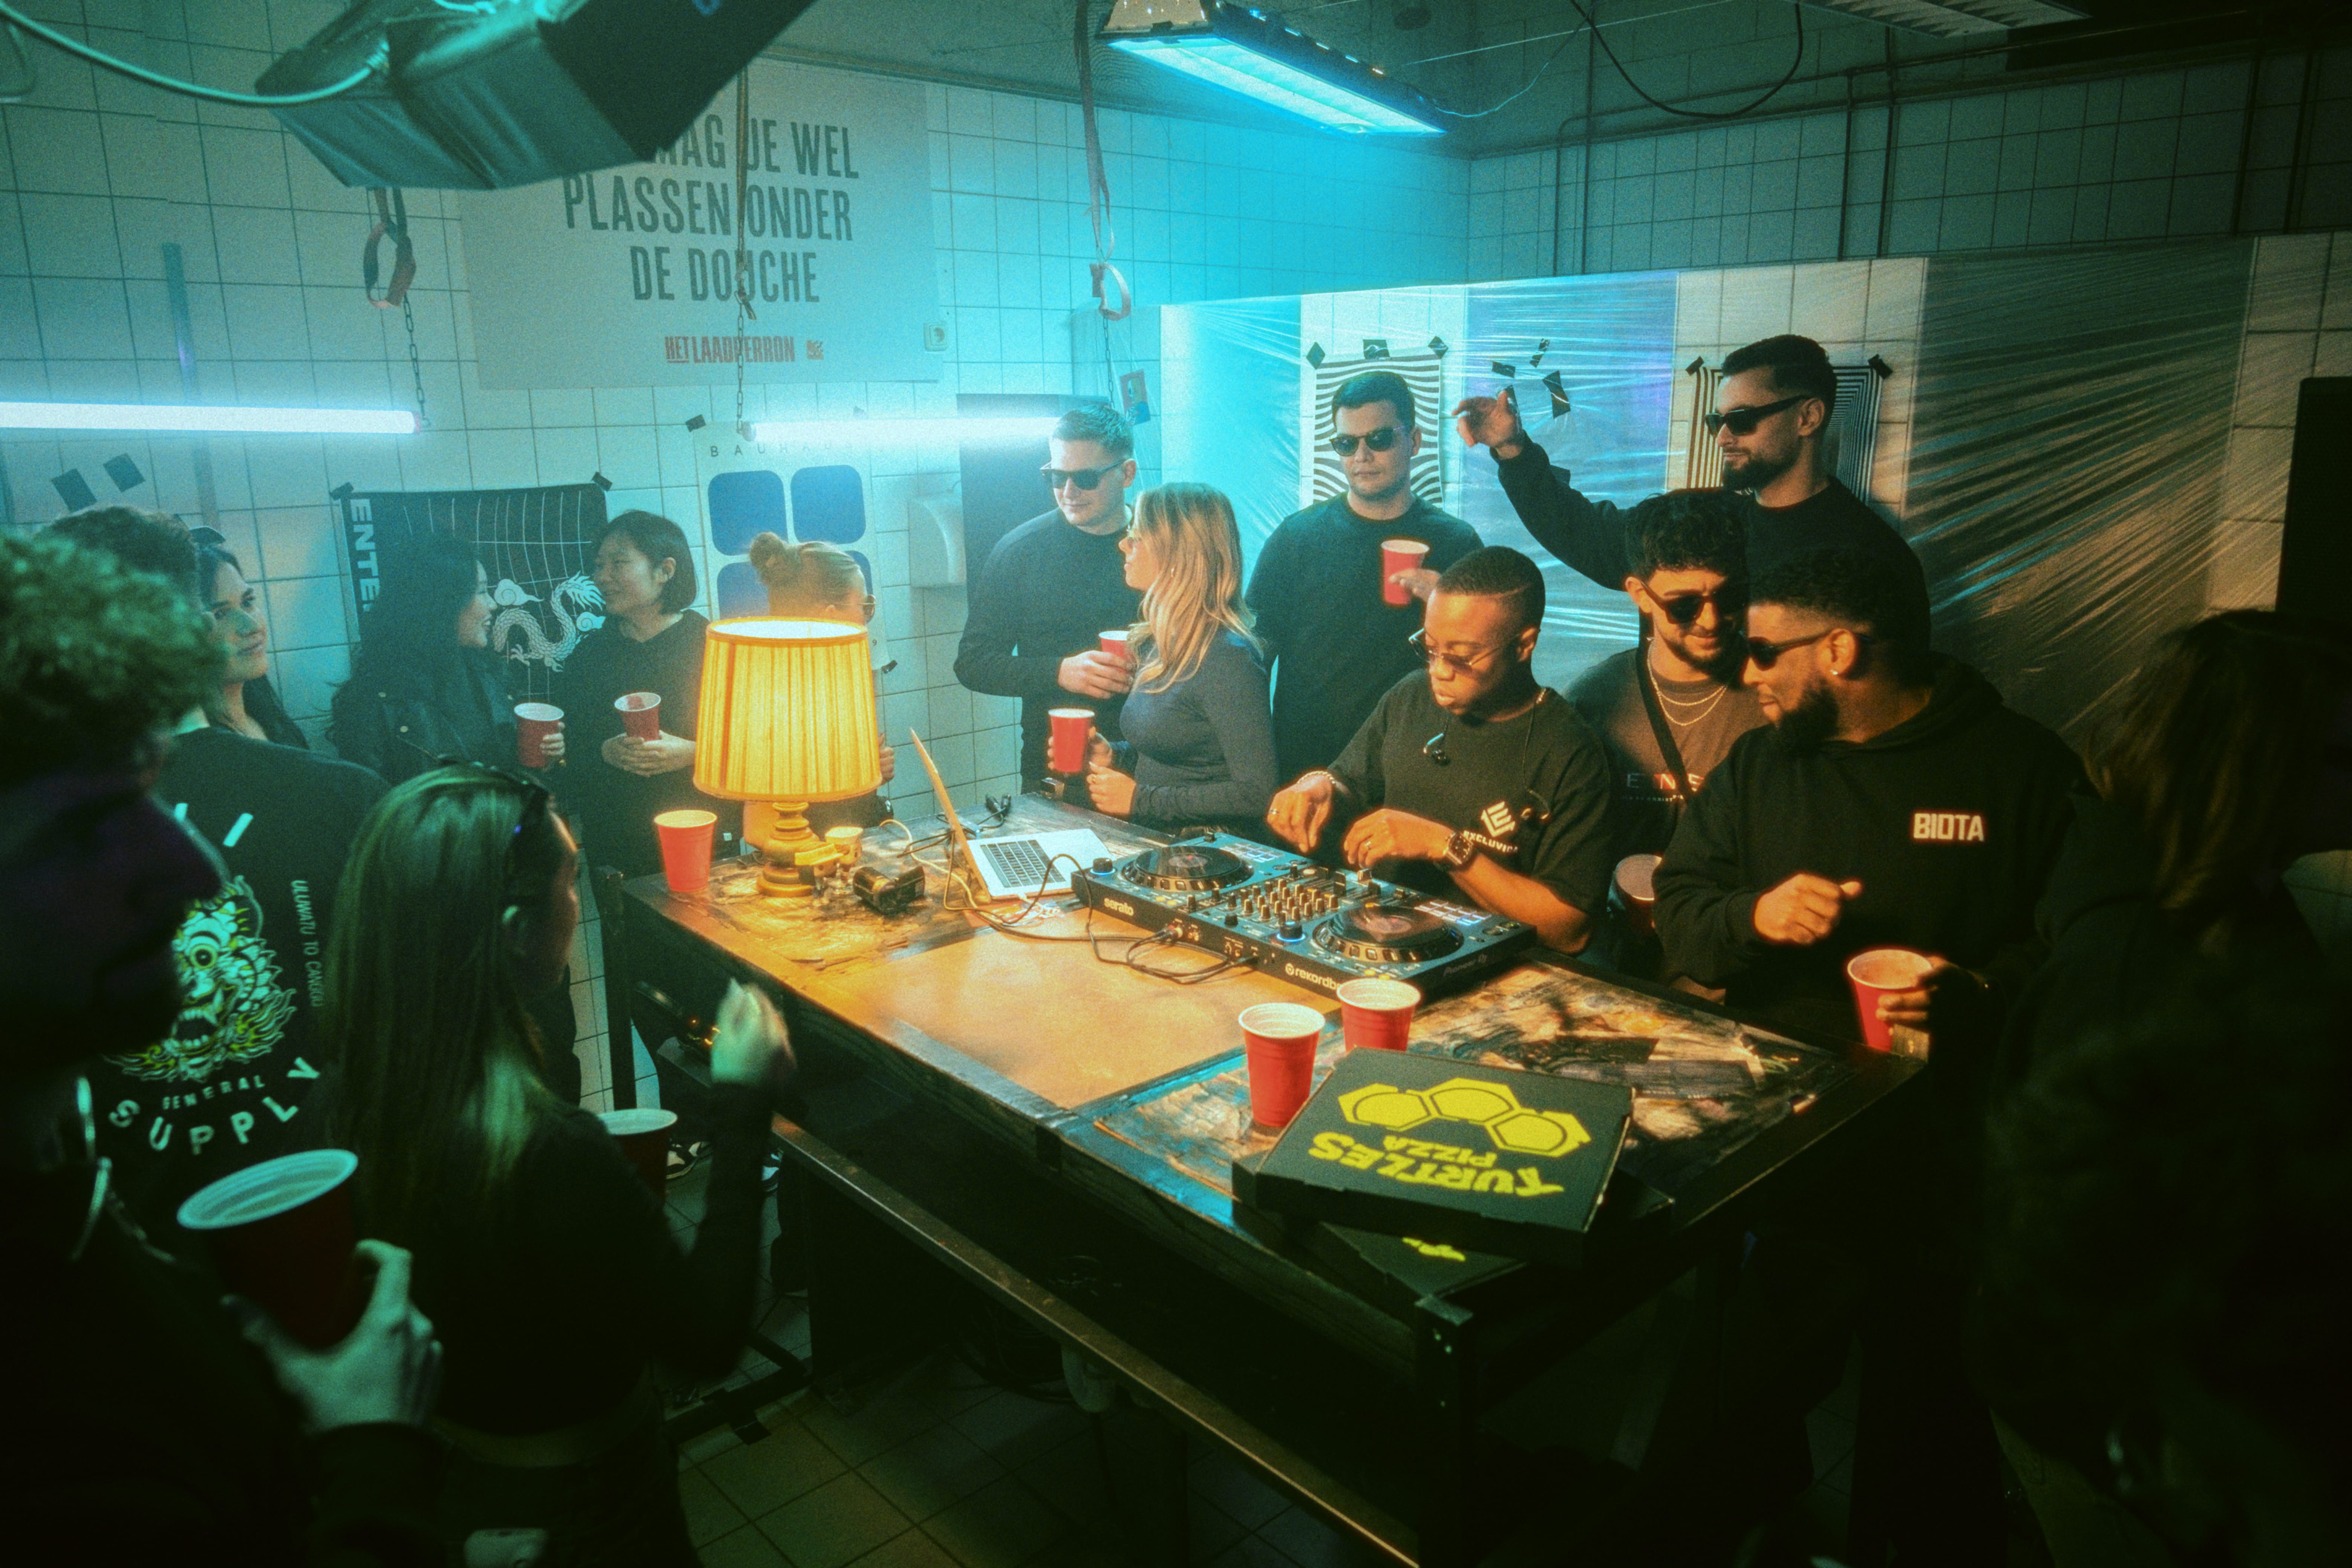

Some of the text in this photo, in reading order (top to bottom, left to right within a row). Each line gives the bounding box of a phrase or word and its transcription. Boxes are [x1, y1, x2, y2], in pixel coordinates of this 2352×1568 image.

[746, 118, 781, 173] JE
[791, 122, 859, 179] WEL
[563, 173, 853, 241] PLASSEN ONDER
[630, 246, 675, 300] DE
[665, 336, 689, 360] HET
[350, 499, 380, 612] ENTE
[1913, 813, 1984, 841] BIOTA
[1104, 897, 1134, 916] serato
[303, 941, 319, 956] TO
[109, 1057, 320, 1155] SUPPLY
[162, 1075, 265, 1110] GENERAL
[1308, 1132, 1564, 1197] TURTLES
[1383, 1135, 1497, 1168] PIZZA
